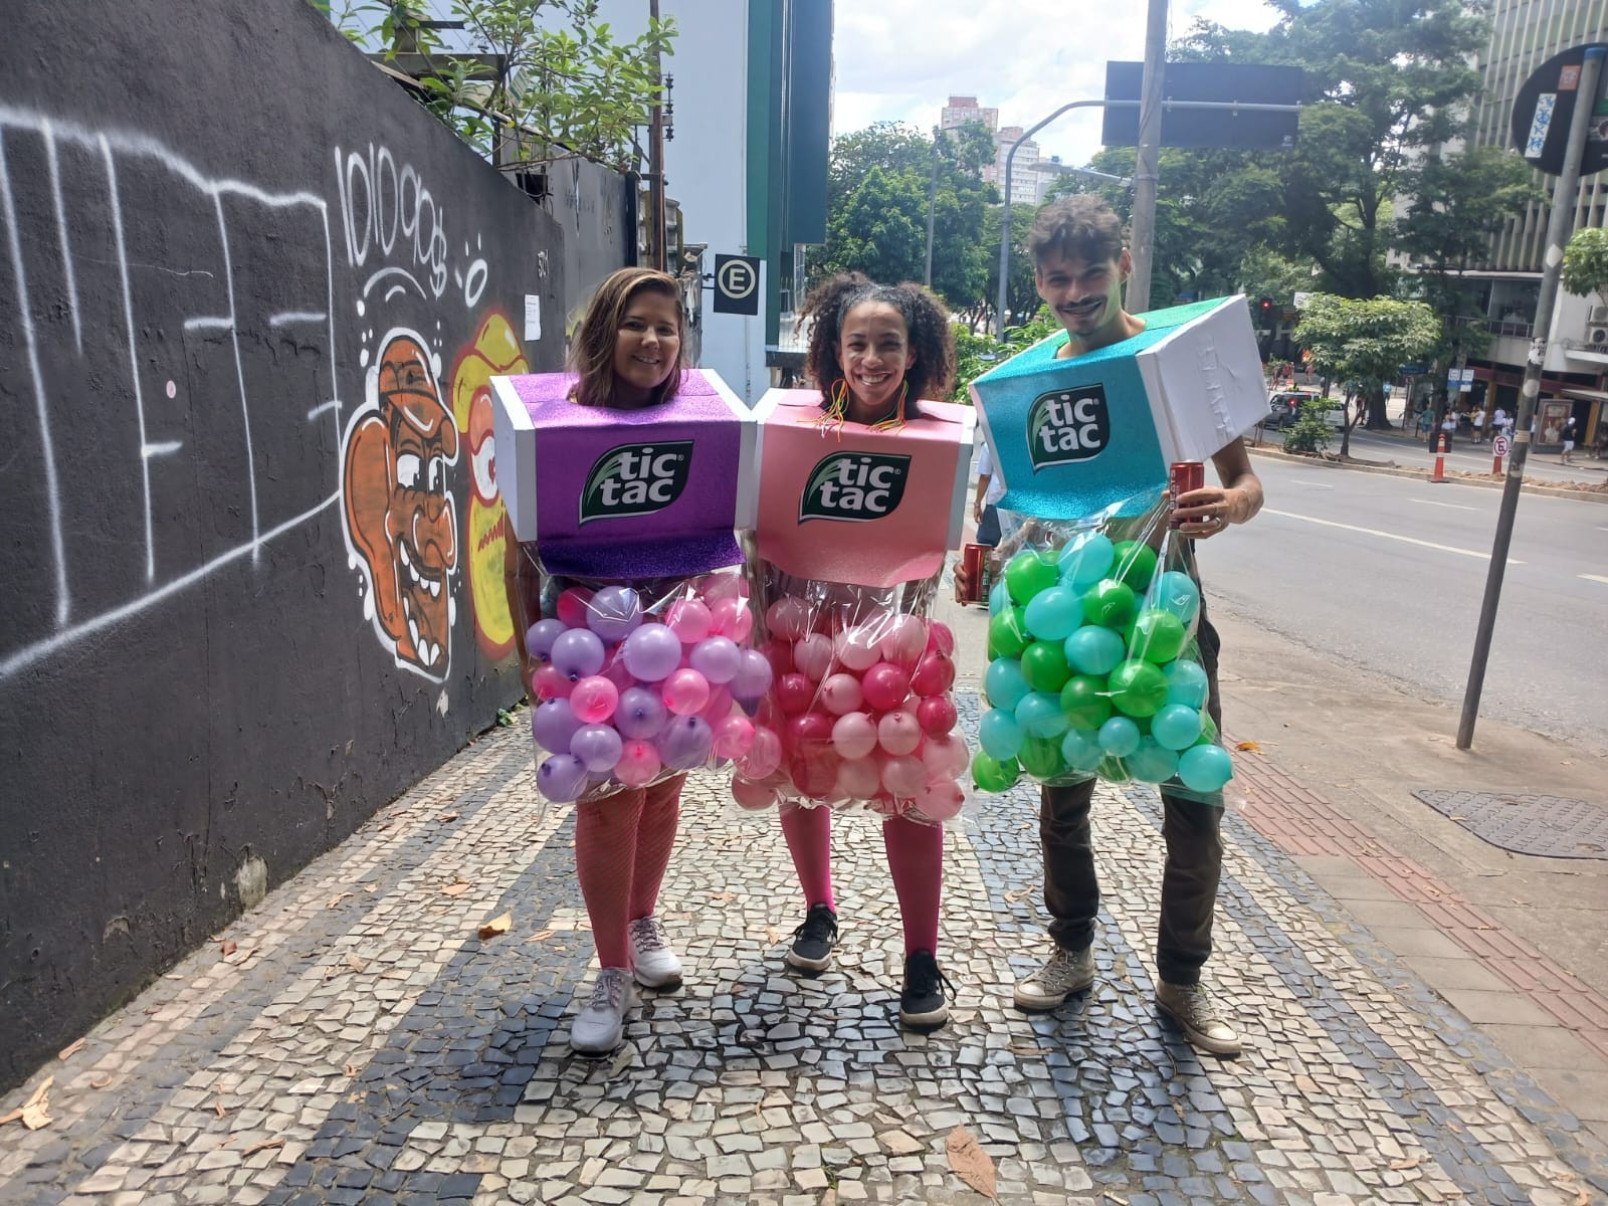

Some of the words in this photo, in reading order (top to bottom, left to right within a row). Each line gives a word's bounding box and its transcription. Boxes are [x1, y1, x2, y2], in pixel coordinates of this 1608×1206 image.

[1045, 394, 1098, 428] tic
[1039, 423, 1102, 454] tac
[619, 447, 677, 481] tic
[838, 457, 895, 489] tic
[600, 477, 674, 507] tac
[820, 480, 889, 513] tac
